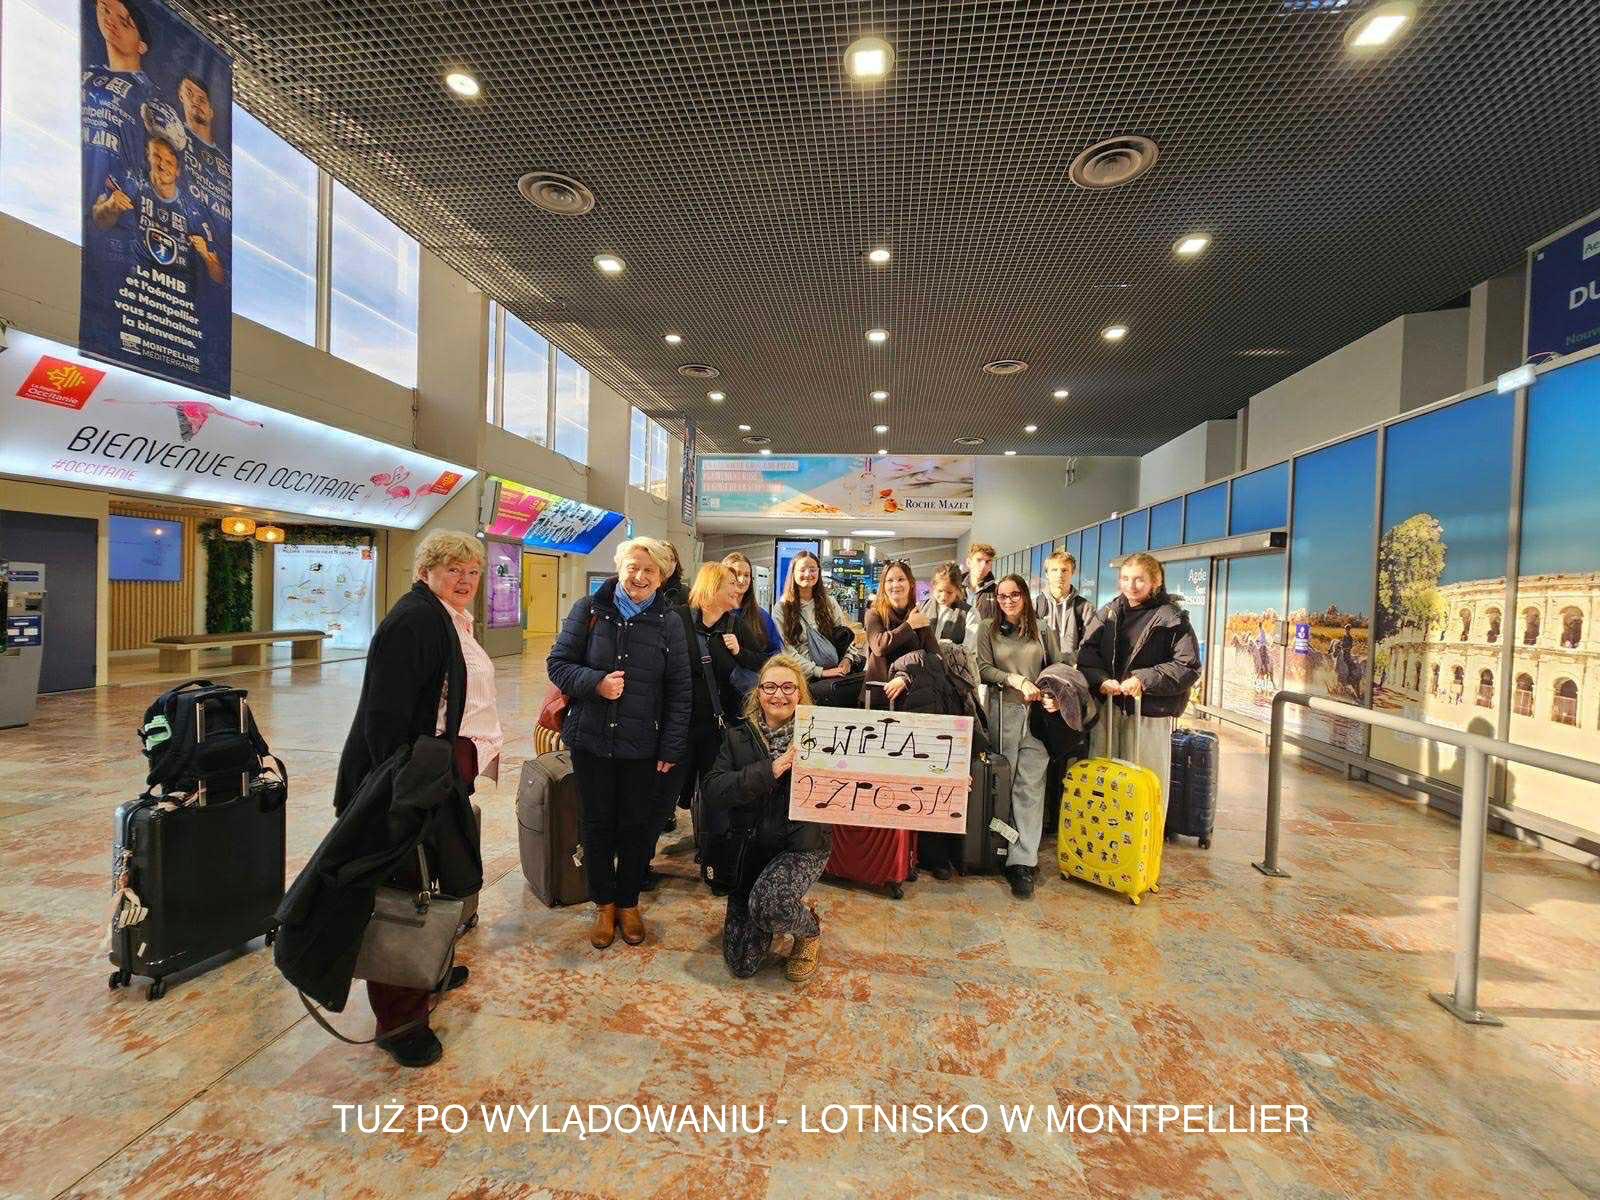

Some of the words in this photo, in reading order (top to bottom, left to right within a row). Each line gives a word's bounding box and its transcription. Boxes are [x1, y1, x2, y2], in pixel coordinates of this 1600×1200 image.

[126, 276, 140, 288] et
[136, 264, 150, 278] Le
[152, 268, 187, 294] MHB
[114, 300, 145, 316] vous
[146, 312, 203, 339] souhaitent
[119, 287, 136, 300] de
[138, 292, 200, 325] Montpellier
[122, 314, 135, 327] la
[142, 339, 200, 365] MONTPELLIER
[51, 459, 138, 481] #OCCITANIE
[66, 425, 235, 478] BIENVENUE
[233, 459, 267, 484] EN
[267, 466, 365, 501] OCCITANIE
